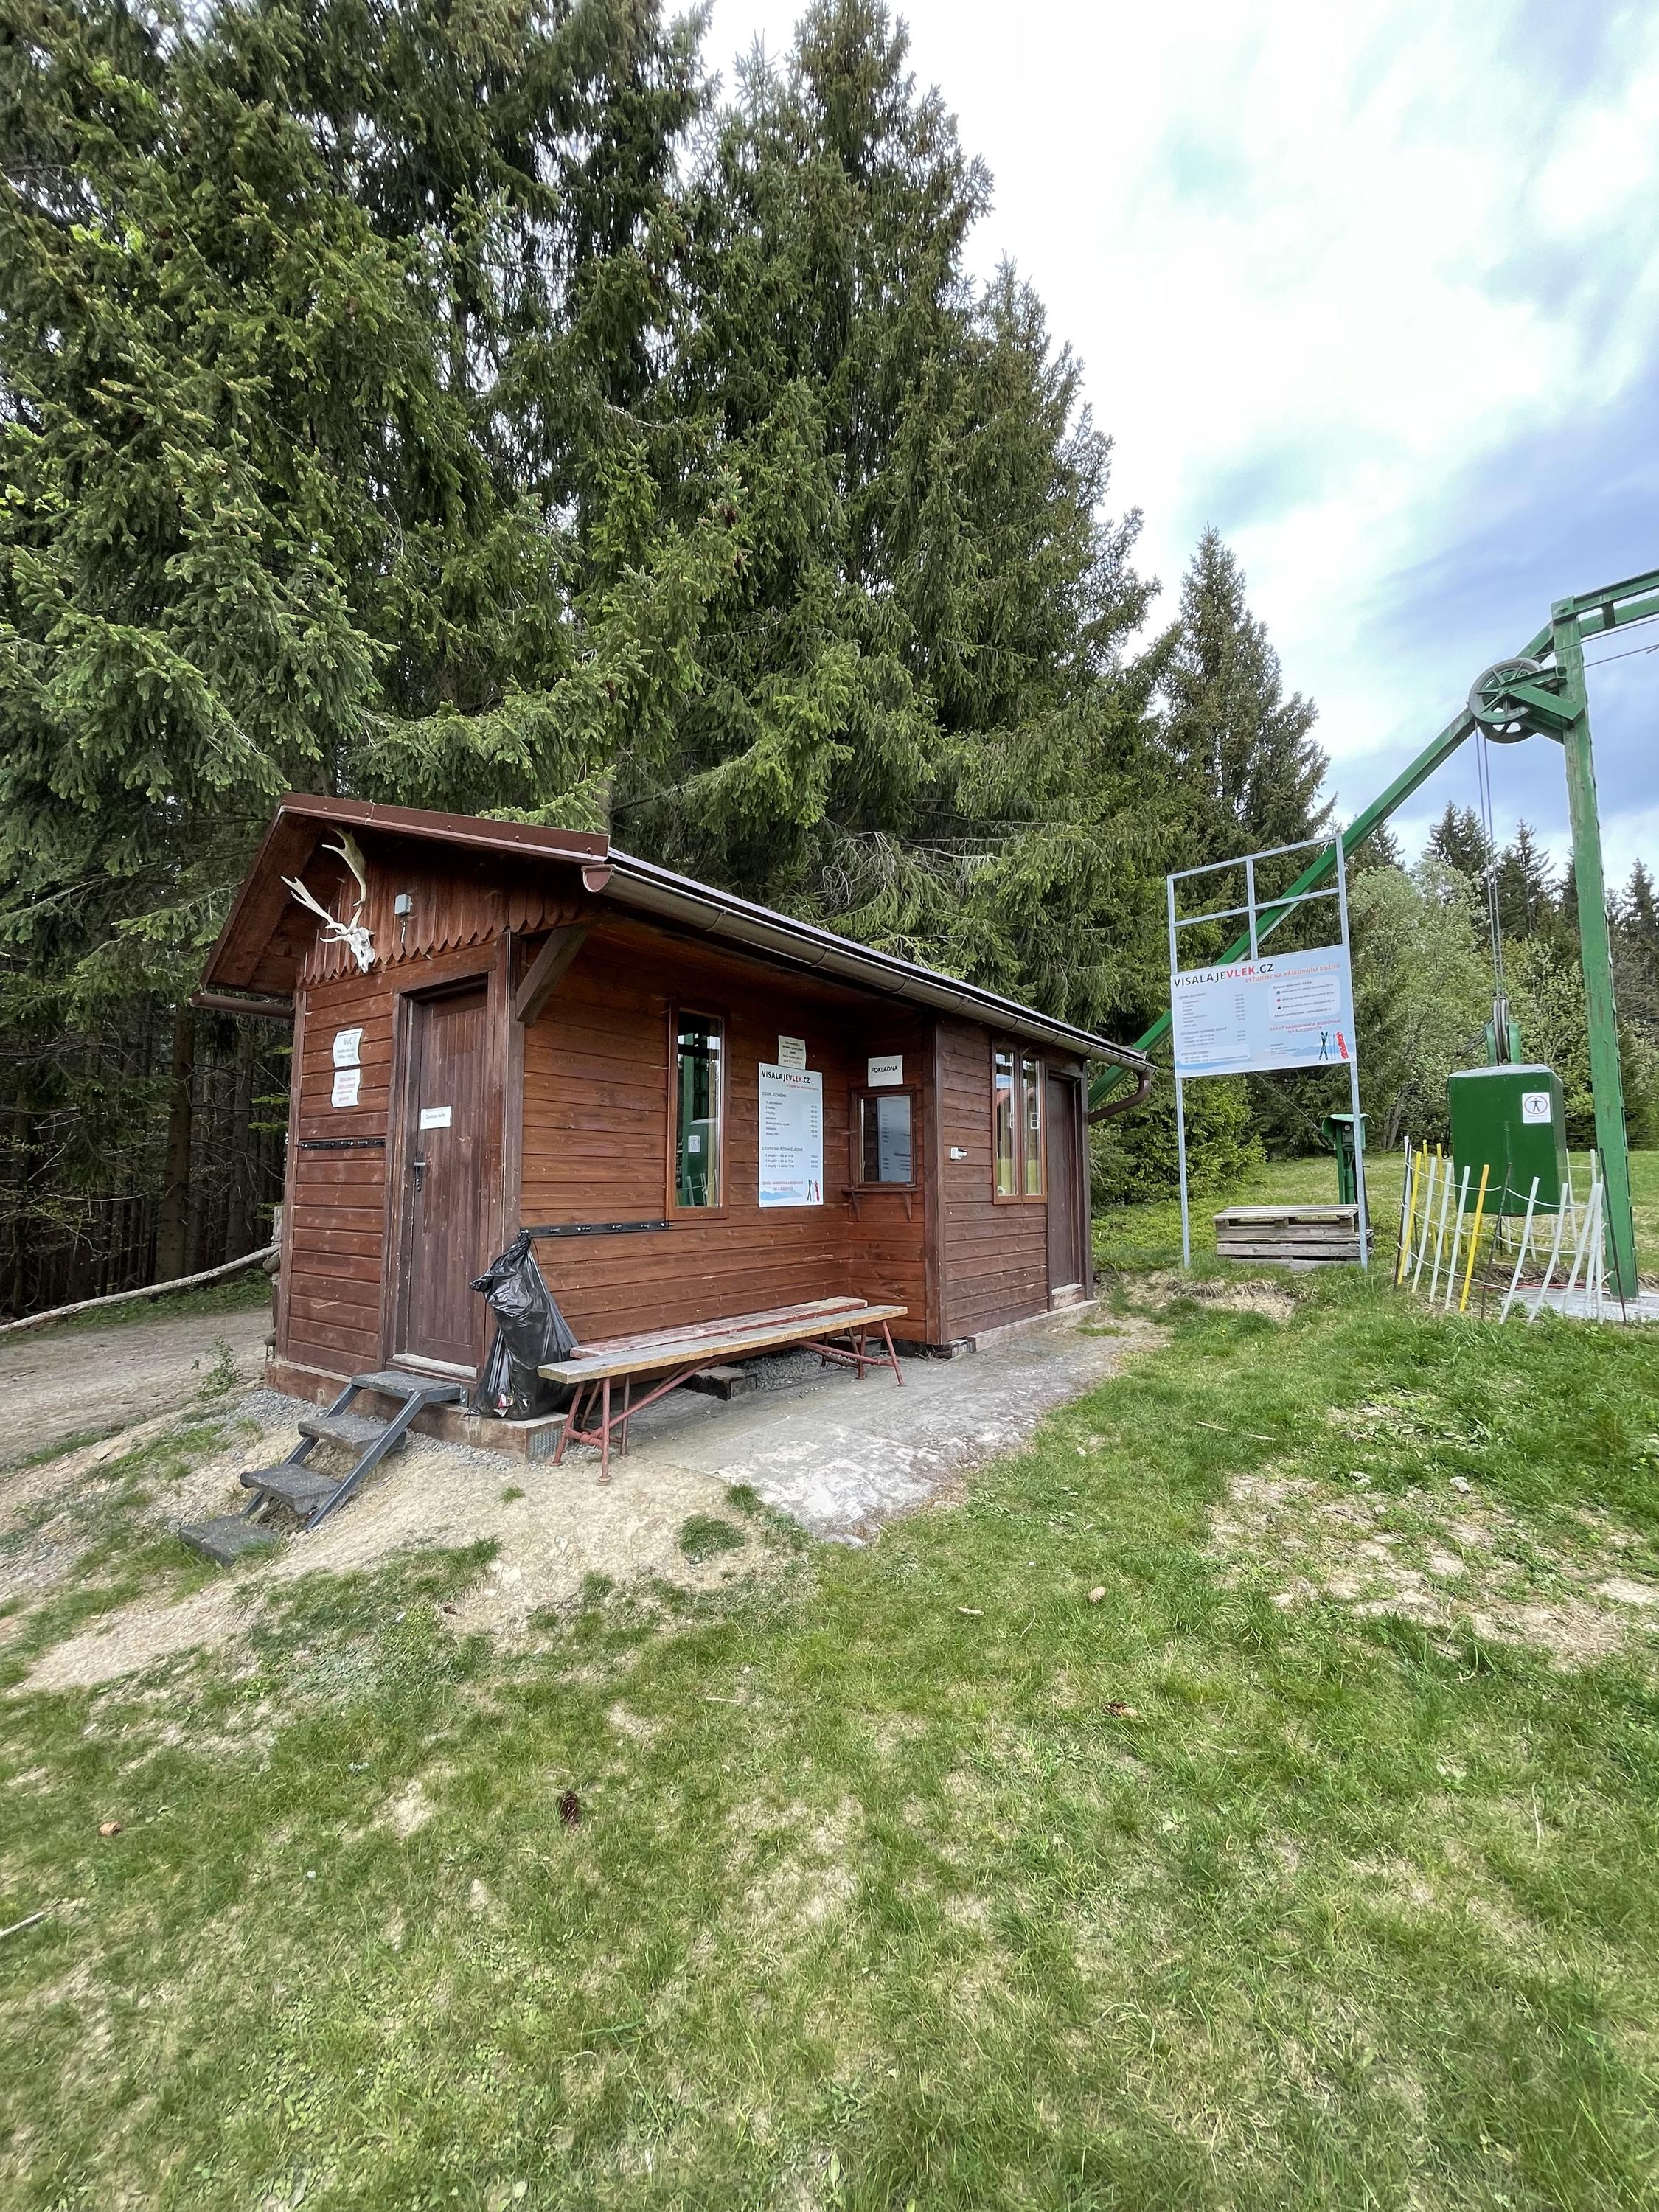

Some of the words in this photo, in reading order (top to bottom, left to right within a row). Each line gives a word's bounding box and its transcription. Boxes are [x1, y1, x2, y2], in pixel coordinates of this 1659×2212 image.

[1174, 963, 1274, 987] VISALAJEVLEK.CZ
[344, 1037, 353, 1045] WC
[871, 1065, 898, 1074] POKLADNA
[762, 1071, 810, 1084] VISALAJEVLEK.CZ
